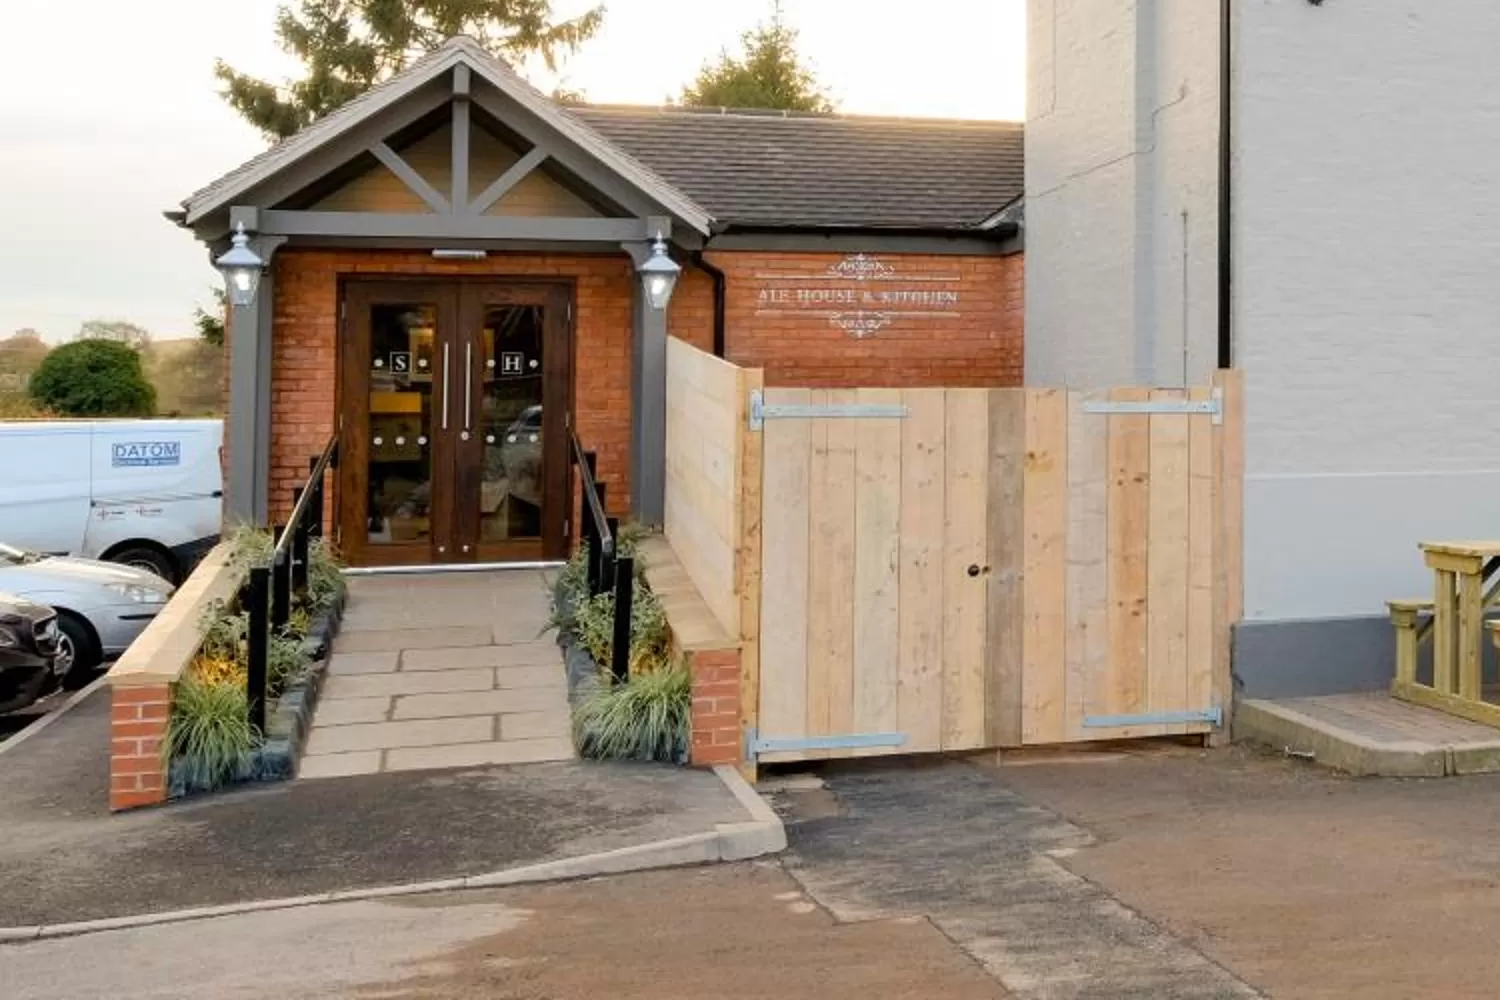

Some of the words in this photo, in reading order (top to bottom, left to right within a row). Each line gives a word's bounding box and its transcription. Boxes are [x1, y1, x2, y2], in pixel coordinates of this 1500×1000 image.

[796, 289, 857, 303] HOUSE
[395, 355, 407, 371] S
[504, 356, 520, 371] H
[115, 443, 177, 457] DATOM
